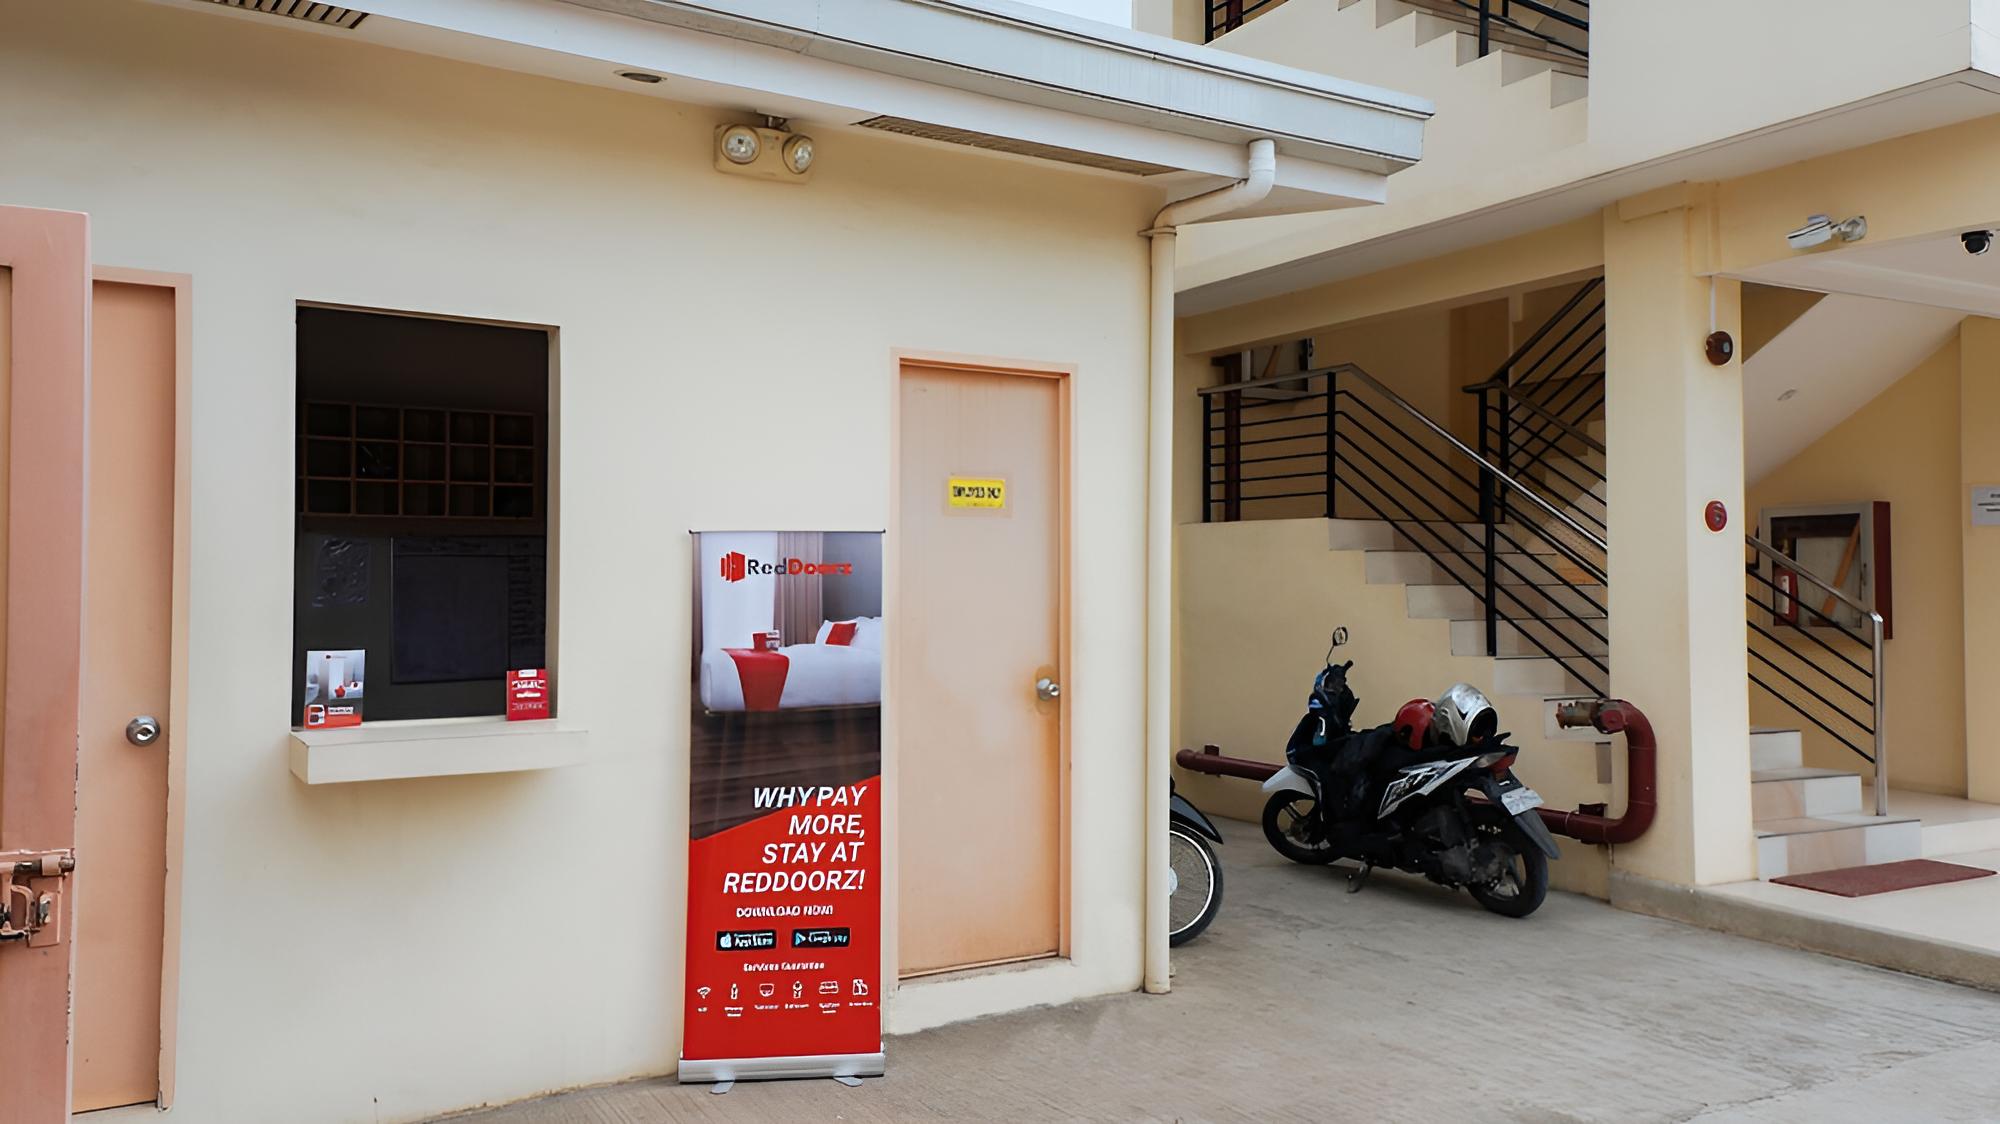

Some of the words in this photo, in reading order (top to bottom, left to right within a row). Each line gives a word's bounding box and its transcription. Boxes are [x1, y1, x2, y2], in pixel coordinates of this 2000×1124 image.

[753, 786, 816, 809] WHY
[816, 785, 868, 807] PAY
[788, 814, 865, 839] MORE,
[761, 841, 826, 864] STAY
[830, 841, 866, 863] AT
[722, 869, 866, 894] REDDOORZ!
